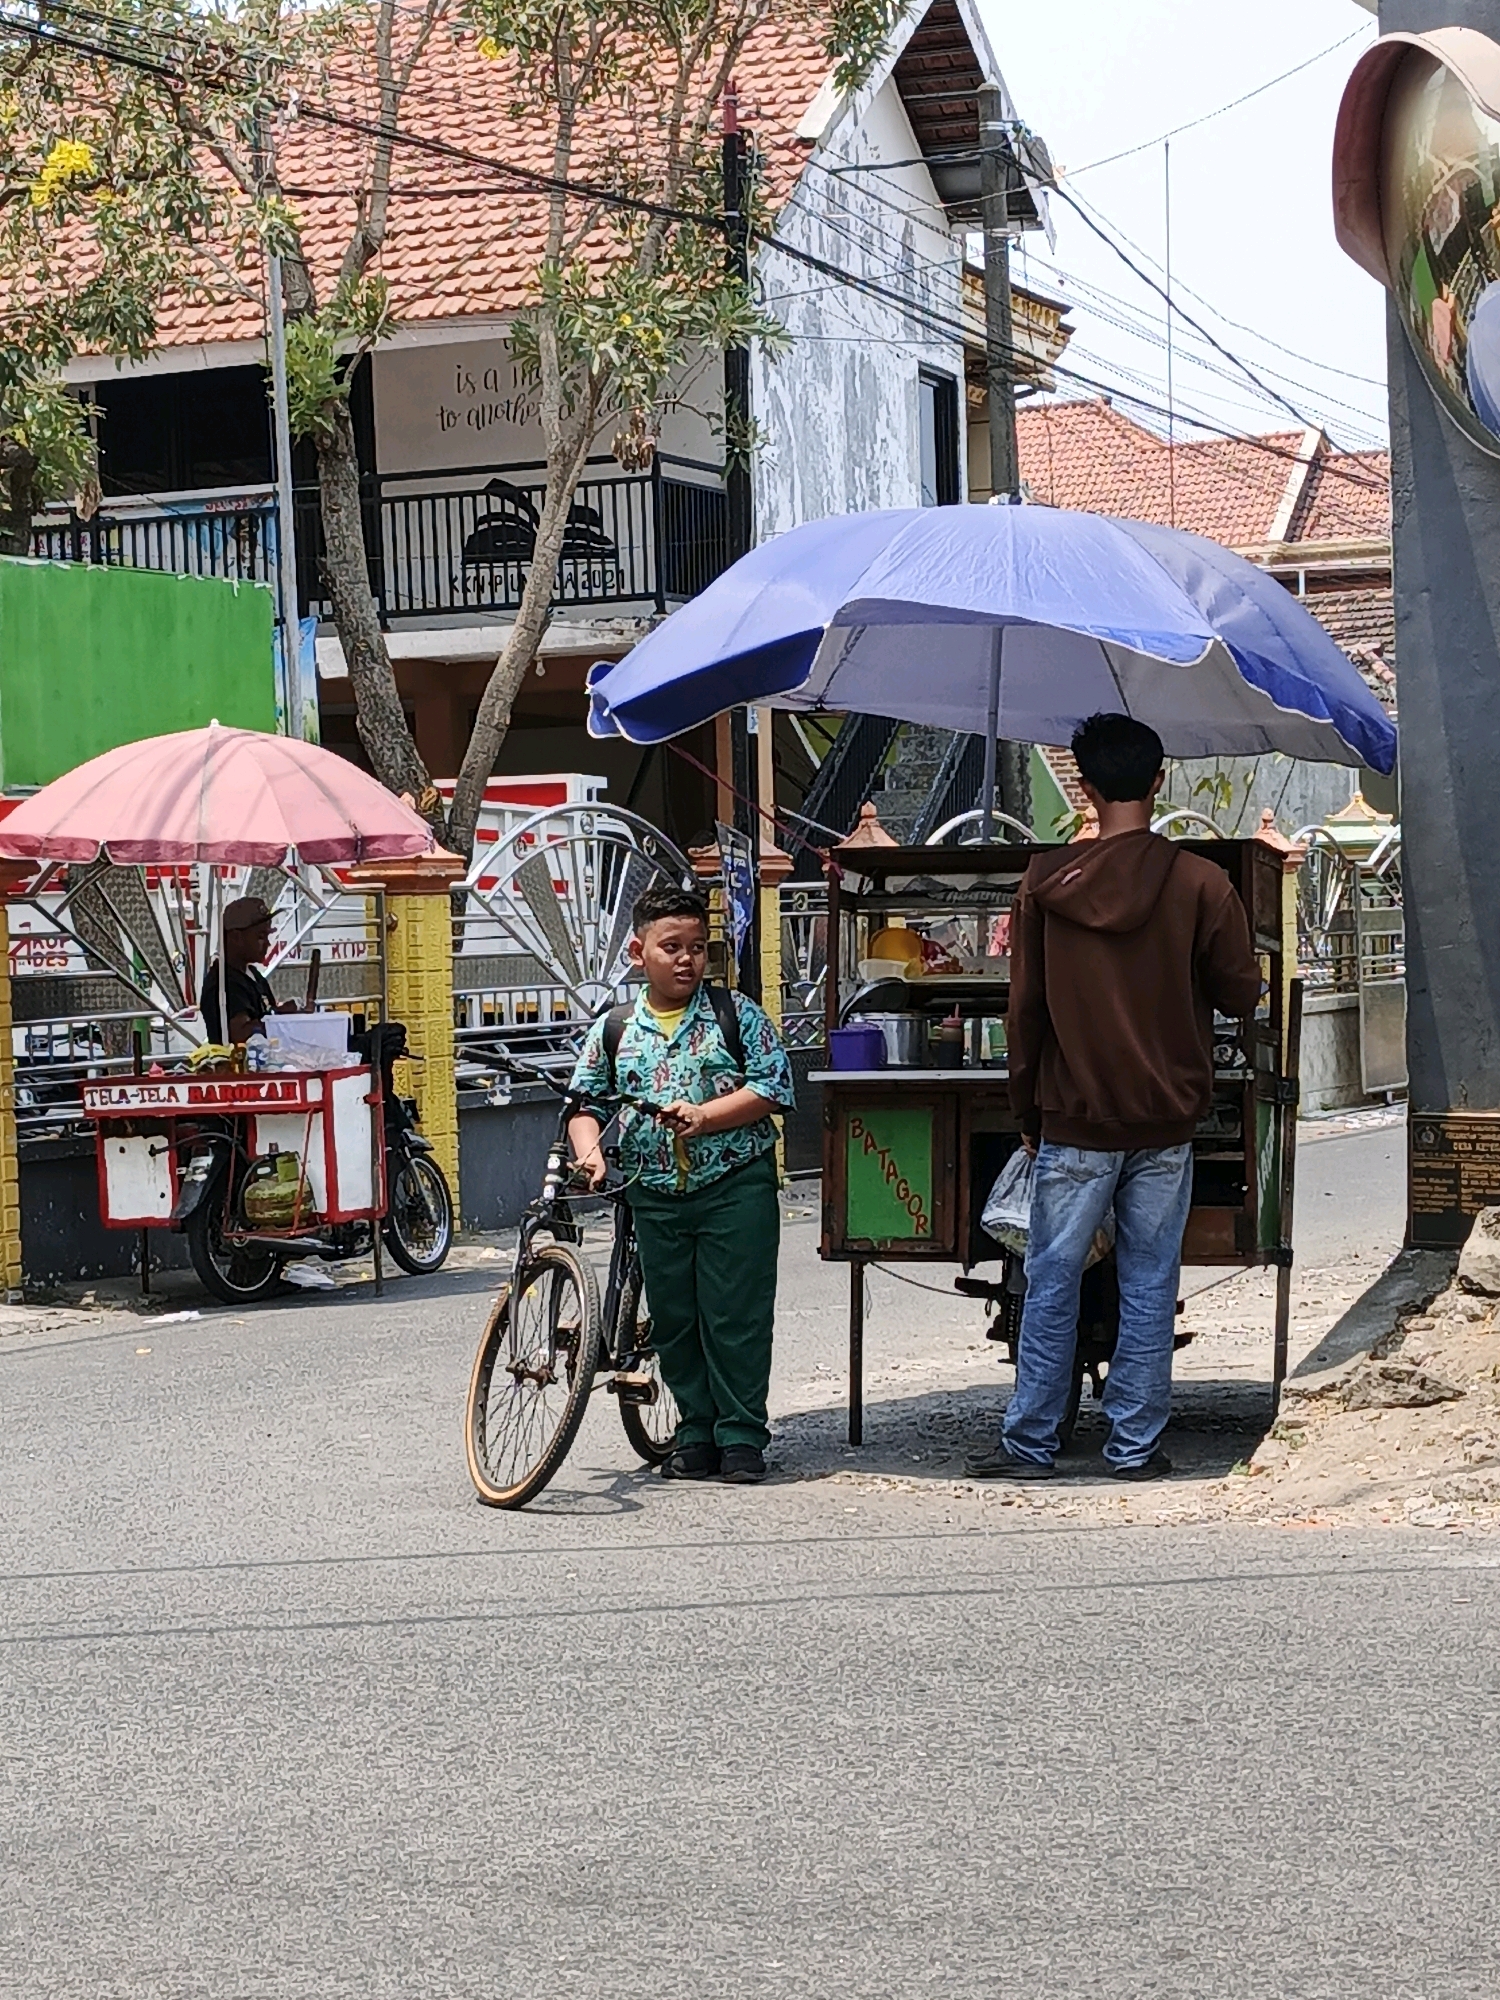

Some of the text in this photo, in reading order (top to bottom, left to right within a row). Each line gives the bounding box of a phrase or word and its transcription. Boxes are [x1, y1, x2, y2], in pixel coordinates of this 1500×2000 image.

[456, 365, 476, 395] is
[484, 368, 498, 393] a
[436, 405, 460, 431] to
[85, 1081, 298, 1107] TELA-TELA BAROKAH
[850, 1117, 928, 1235] BATAGOR
